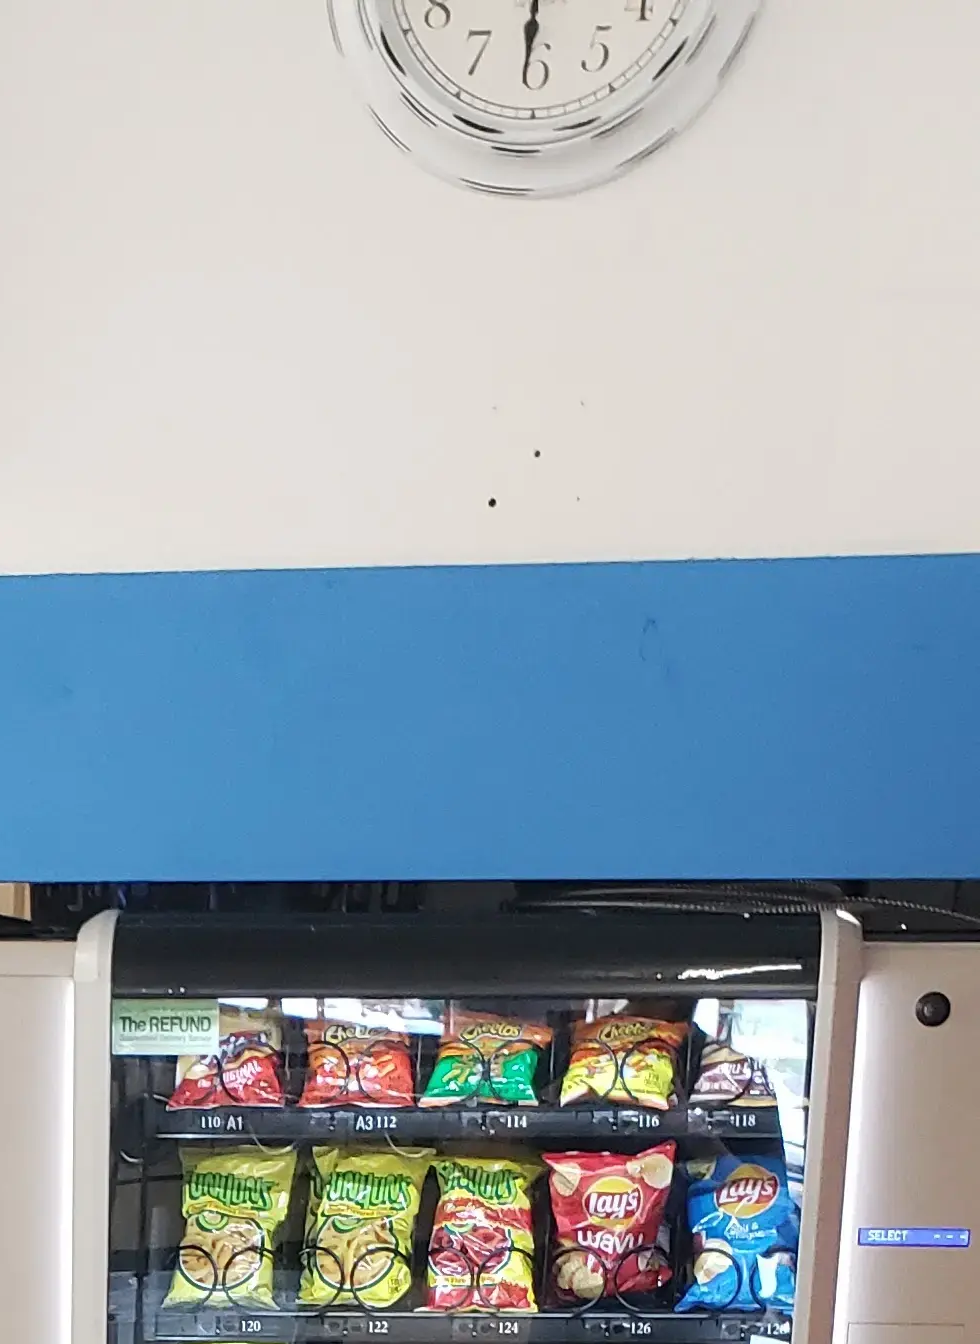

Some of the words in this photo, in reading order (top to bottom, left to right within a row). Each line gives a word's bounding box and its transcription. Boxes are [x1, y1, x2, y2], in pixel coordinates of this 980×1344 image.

[465, 30, 493, 76] 7
[581, 25, 612, 72] 5
[522, 42, 550, 91] 6
[119, 1016, 146, 1032] The
[149, 1016, 211, 1032] REFUND
[200, 1116, 220, 1128] 110
[226, 1115, 243, 1130] A1
[356, 1115, 373, 1130] A3
[377, 1115, 397, 1128] 112
[507, 1115, 527, 1128] 114
[639, 1114, 660, 1128] 116
[734, 1114, 756, 1127] 118
[187, 1170, 274, 1211] UNYUNS
[327, 1170, 412, 1211] UNYUNS
[719, 1177, 774, 1214] Lay's
[589, 1189, 639, 1220] Lay's
[868, 1230, 908, 1242] SELECT
[240, 1320, 261, 1332] 120
[368, 1321, 388, 1333] 122
[498, 1322, 518, 1334] 124
[631, 1322, 651, 1335] 126
